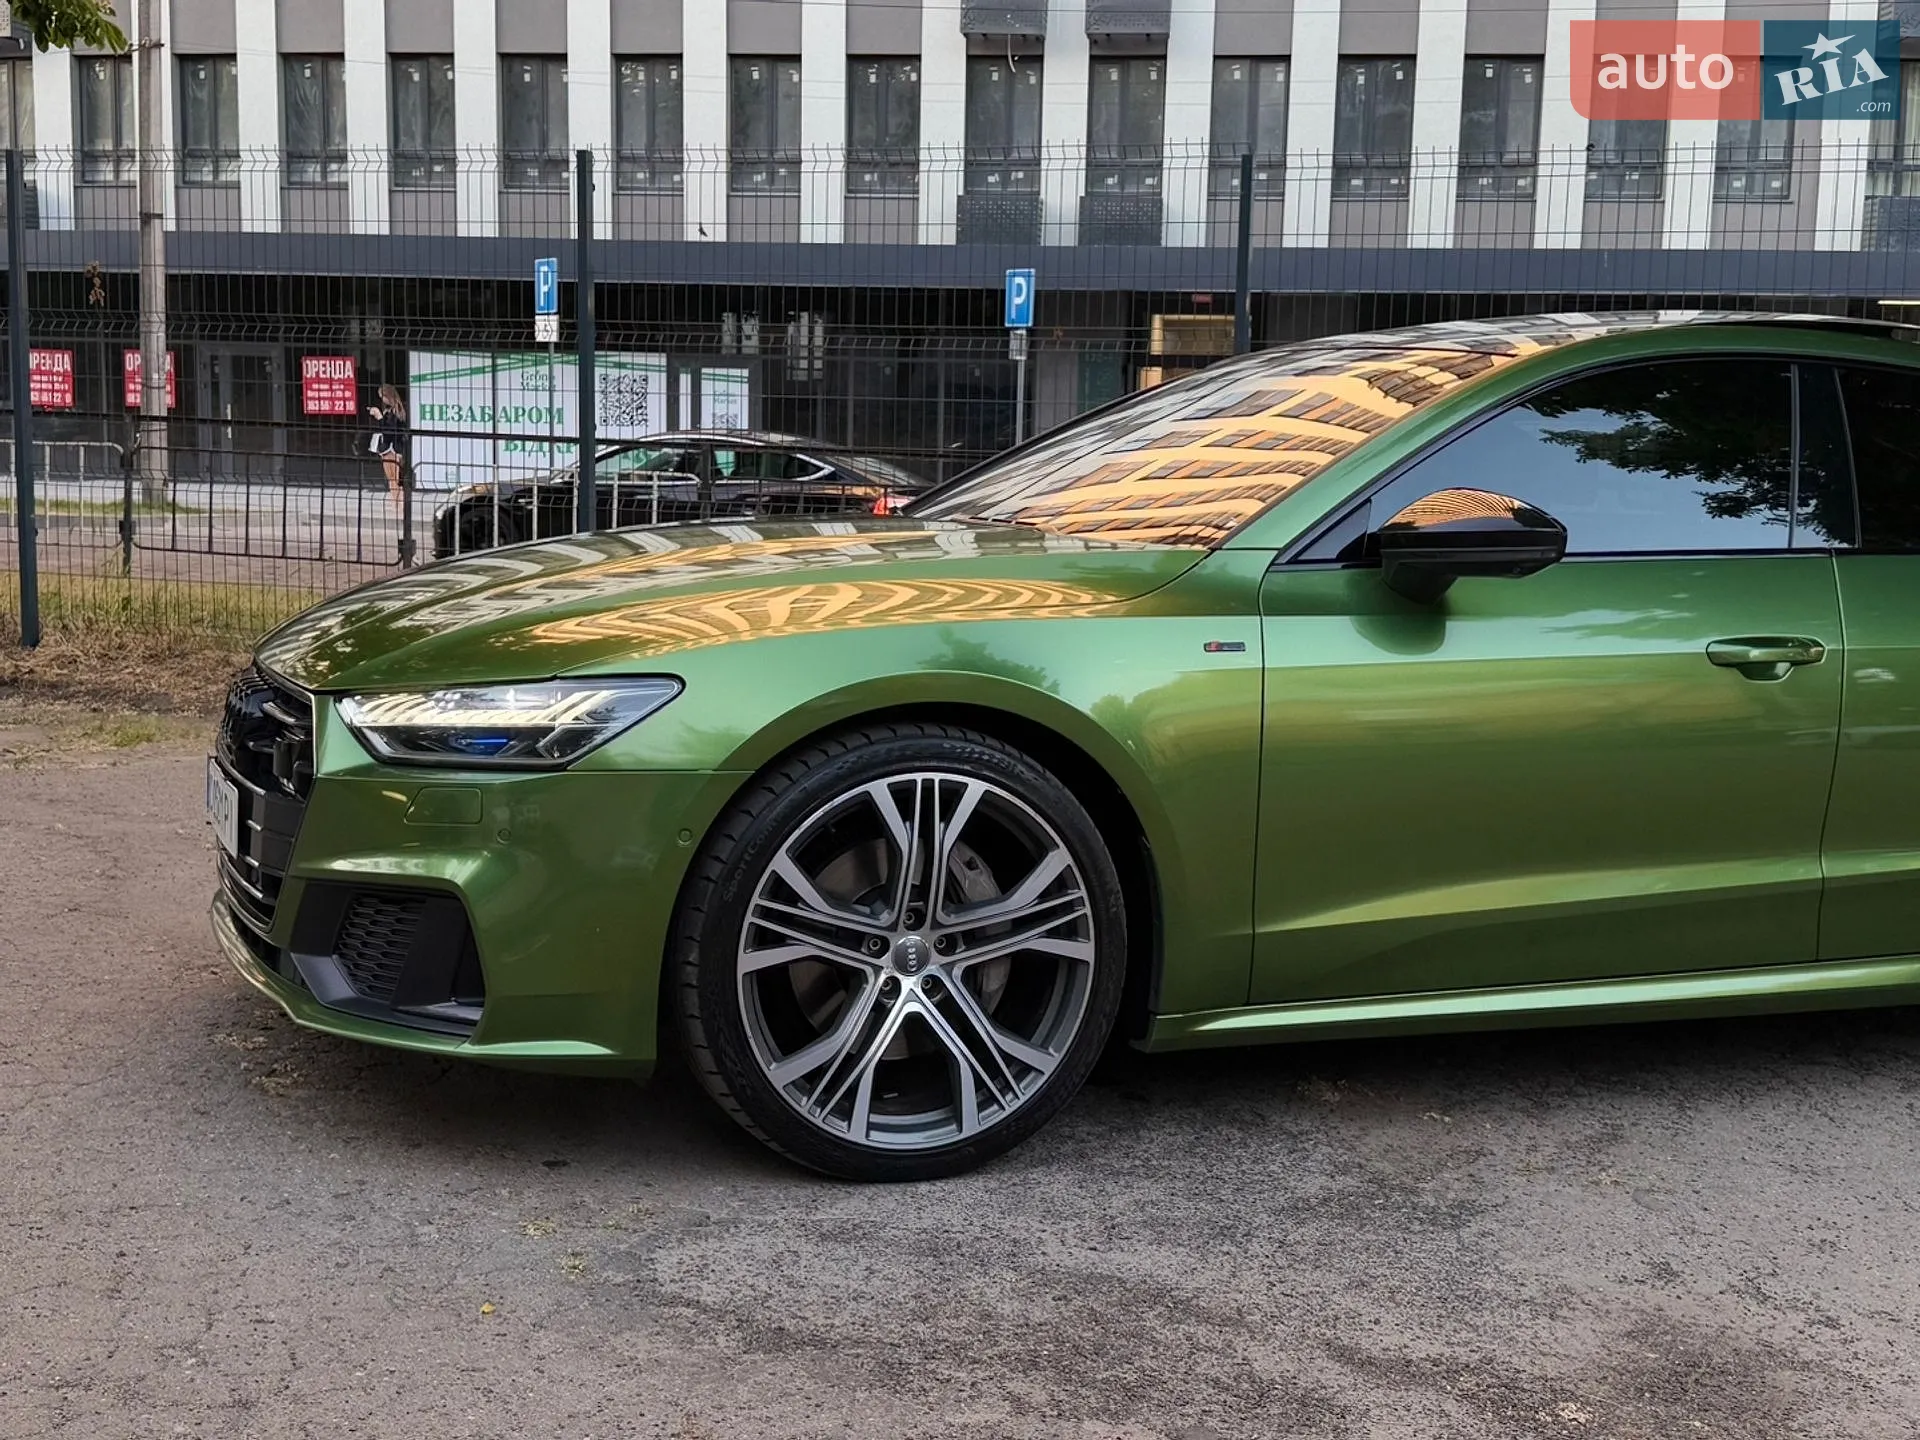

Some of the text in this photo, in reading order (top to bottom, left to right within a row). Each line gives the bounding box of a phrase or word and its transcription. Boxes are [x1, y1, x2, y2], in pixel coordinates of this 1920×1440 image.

[539, 265, 552, 307] P
[1010, 276, 1026, 320] P
[304, 360, 354, 379] ОРЕНДА
[419, 404, 564, 425] НЕЗАБАРОМ
